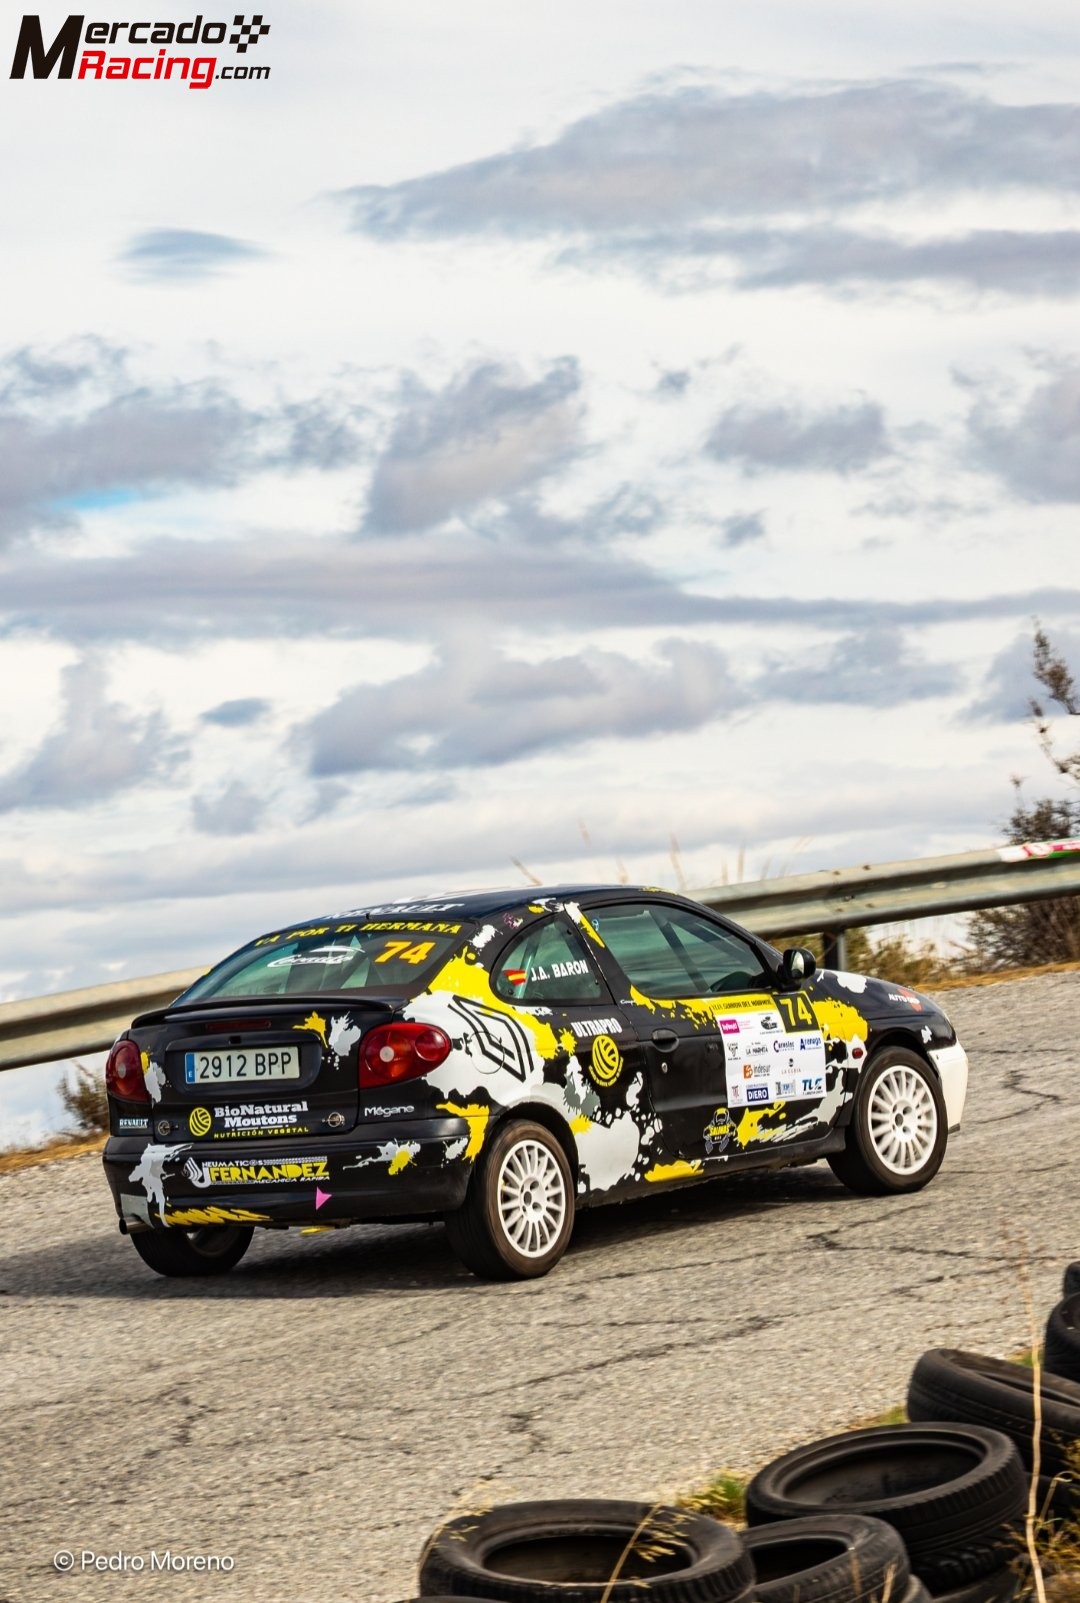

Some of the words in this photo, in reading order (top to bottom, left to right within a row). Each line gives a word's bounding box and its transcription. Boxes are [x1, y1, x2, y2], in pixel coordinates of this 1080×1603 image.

[286, 927, 330, 940] POR
[335, 924, 358, 934] TI
[360, 921, 462, 934] HERMANA
[374, 941, 436, 965] 74
[531, 965, 551, 982] J.A.
[551, 959, 589, 978] BARON
[780, 996, 813, 1026] 74
[570, 1017, 622, 1038] ULTRAPRO
[200, 1054, 247, 1079] 2912
[255, 1052, 291, 1076] BPP
[747, 1088, 768, 1099] DIERO
[214, 1101, 309, 1118] BioNatural
[364, 1105, 415, 1118] Mégane
[224, 1114, 298, 1128] Moutons
[267, 1127, 309, 1135] VEGETAL
[209, 1162, 329, 1182] FERNANDEZ
